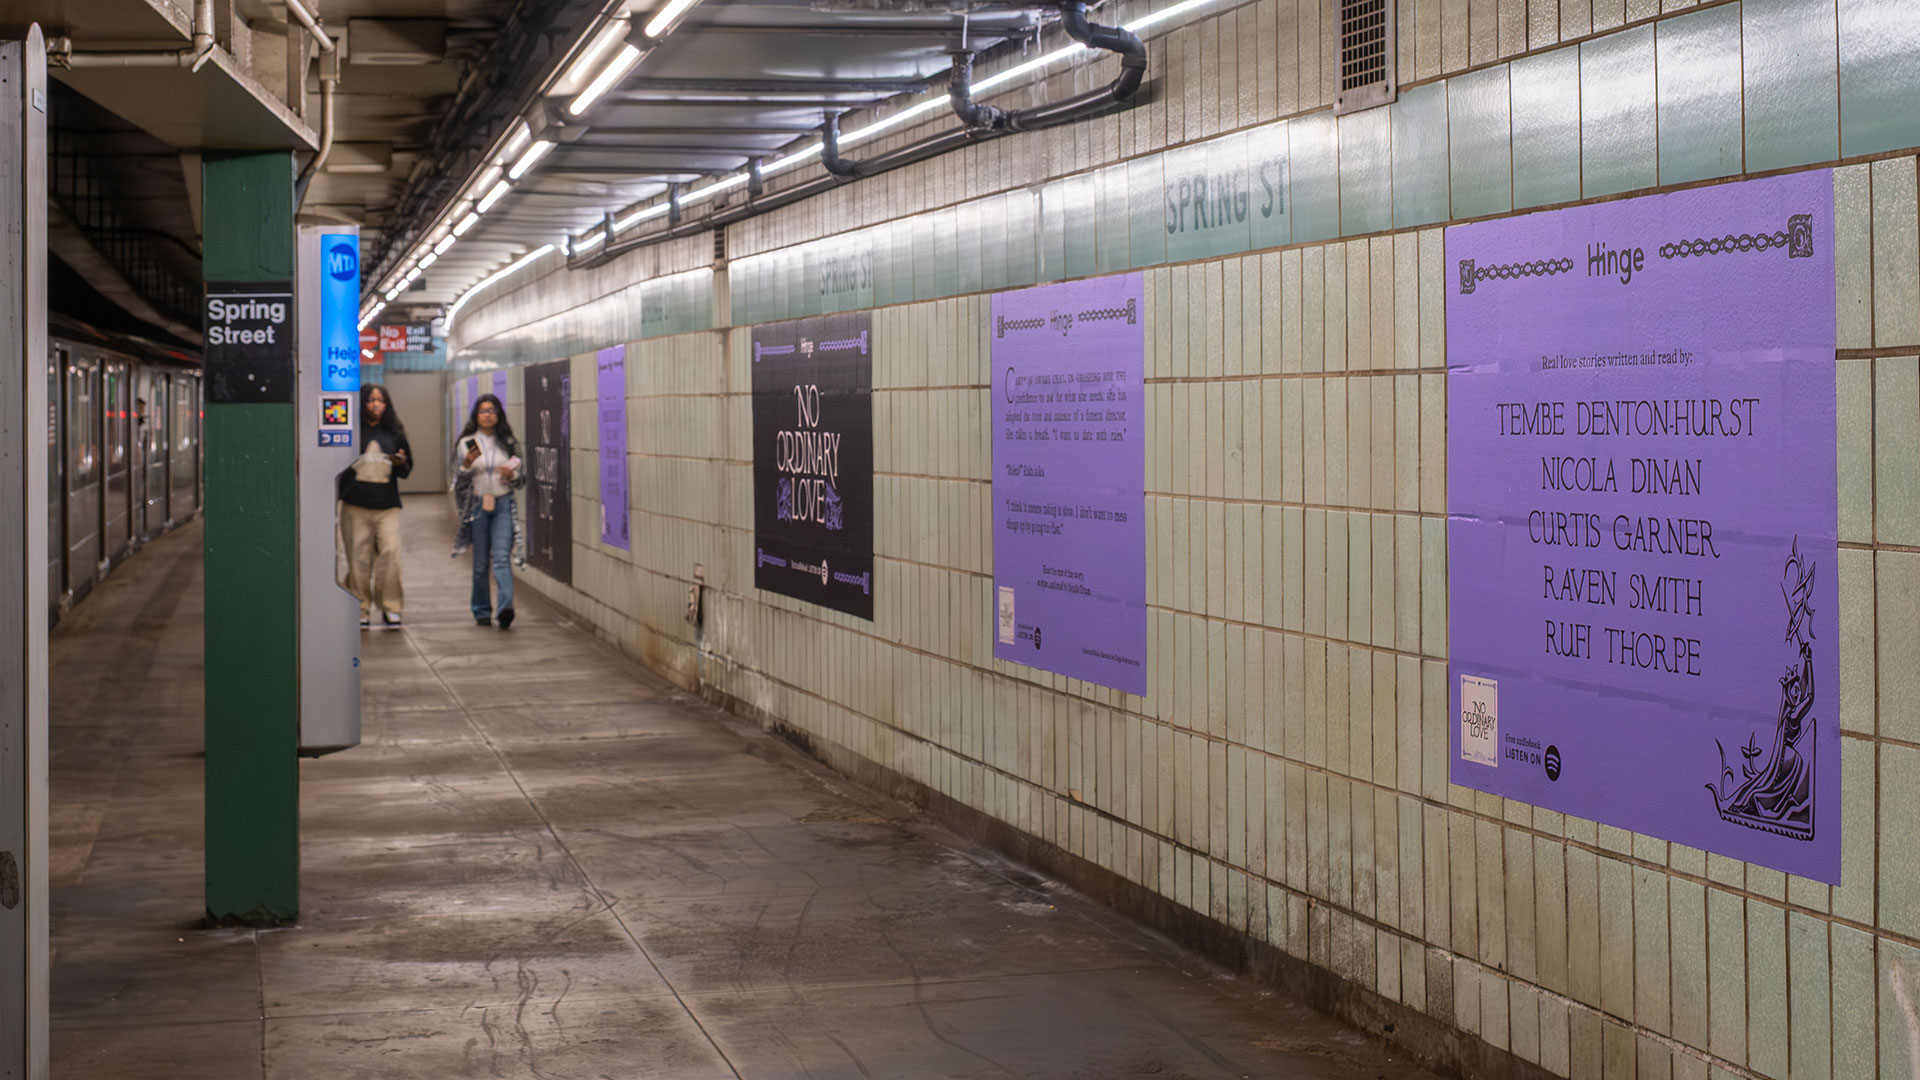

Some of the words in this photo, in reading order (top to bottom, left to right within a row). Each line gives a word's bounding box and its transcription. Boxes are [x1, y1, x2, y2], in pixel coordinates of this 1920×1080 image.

[1166, 173, 1247, 234] SPRING
[1260, 157, 1287, 218] ST
[819, 257, 857, 296] SPRING
[860, 249, 874, 289] ST
[1587, 243, 1644, 285] Hinge
[208, 299, 286, 324] Spring
[1050, 309, 1073, 337] Hinge
[208, 326, 276, 345] Street
[380, 326, 400, 338] No
[380, 338, 406, 350] Exit
[1541, 354, 1559, 371] Real
[1560, 353, 1578, 369] love
[1578, 353, 1606, 369] stories
[1607, 352, 1638, 367] written
[1639, 351, 1656, 366] and
[1657, 350, 1678, 365] read
[1679, 349, 1694, 367] by:
[794, 384, 820, 428] NO
[1496, 402, 1565, 436] TEMBE
[1576, 398, 1760, 436] DENTON-HURST
[777, 431, 840, 489] ORDINARY
[1541, 456, 1618, 492] NICOLA
[1630, 458, 1702, 496] DINAN
[791, 477, 825, 523] LOVE
[1528, 510, 1601, 548] CURTIS
[1612, 514, 1720, 559] GARNER
[1543, 565, 1617, 606] RAVEN
[1629, 573, 1703, 616] SMITH
[1545, 620, 1591, 659] RUFI
[1604, 627, 1701, 676] THORPE
[1462, 711, 1496, 731] ORDINARY
[1472, 701, 1487, 715] NO
[1469, 723, 1489, 740] LOVE
[1505, 732, 1516, 745] Free
[1505, 747, 1529, 763] LISTEN
[1530, 752, 1542, 766] ON
